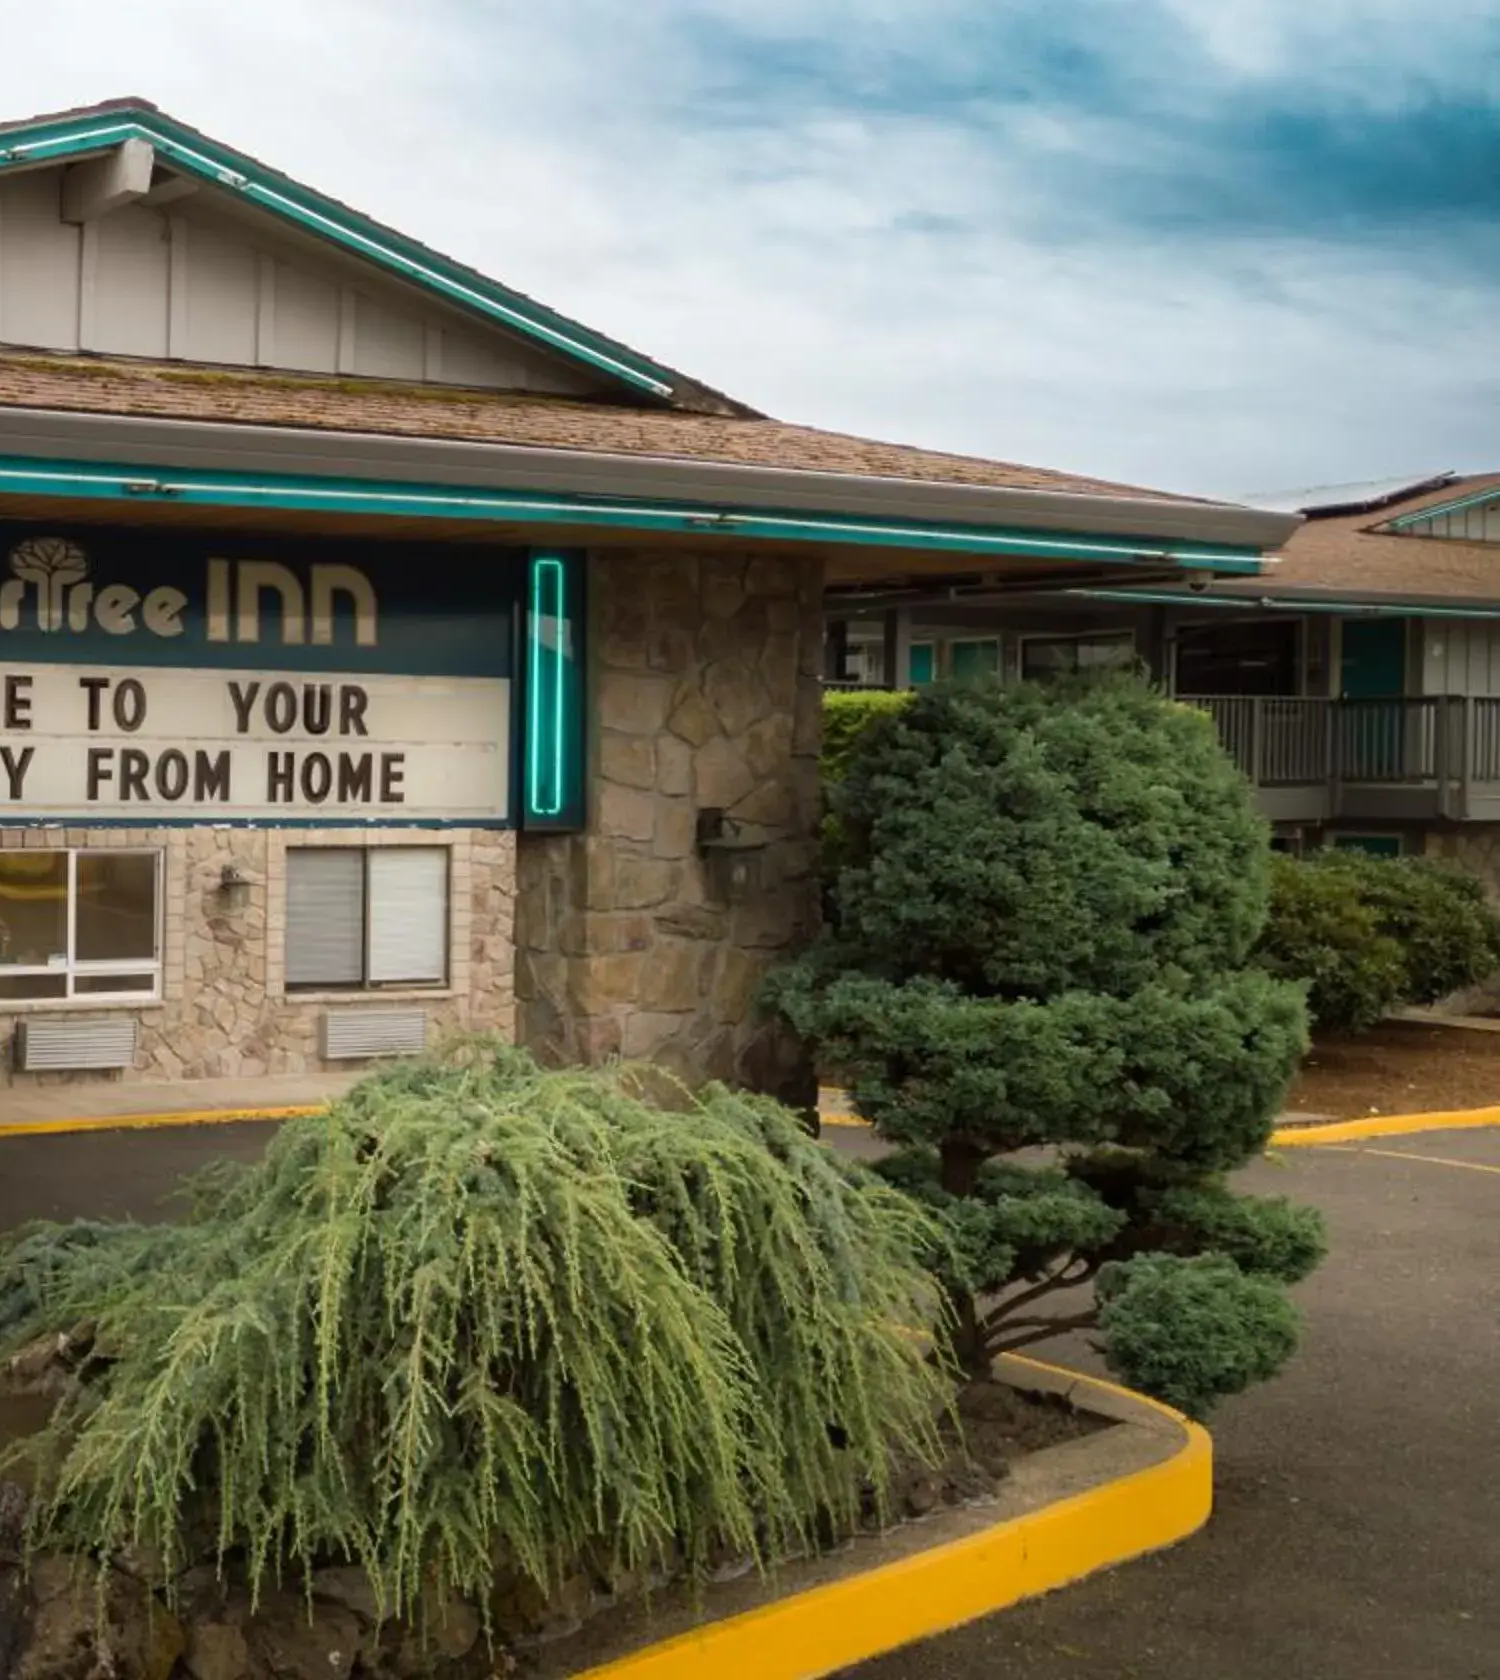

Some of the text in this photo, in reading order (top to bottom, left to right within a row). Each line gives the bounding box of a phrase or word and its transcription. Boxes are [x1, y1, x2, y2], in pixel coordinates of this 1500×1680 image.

[78, 676, 148, 733] TO
[226, 680, 370, 737] YOUR
[85, 747, 232, 803] FROM
[266, 750, 406, 804] HOME
